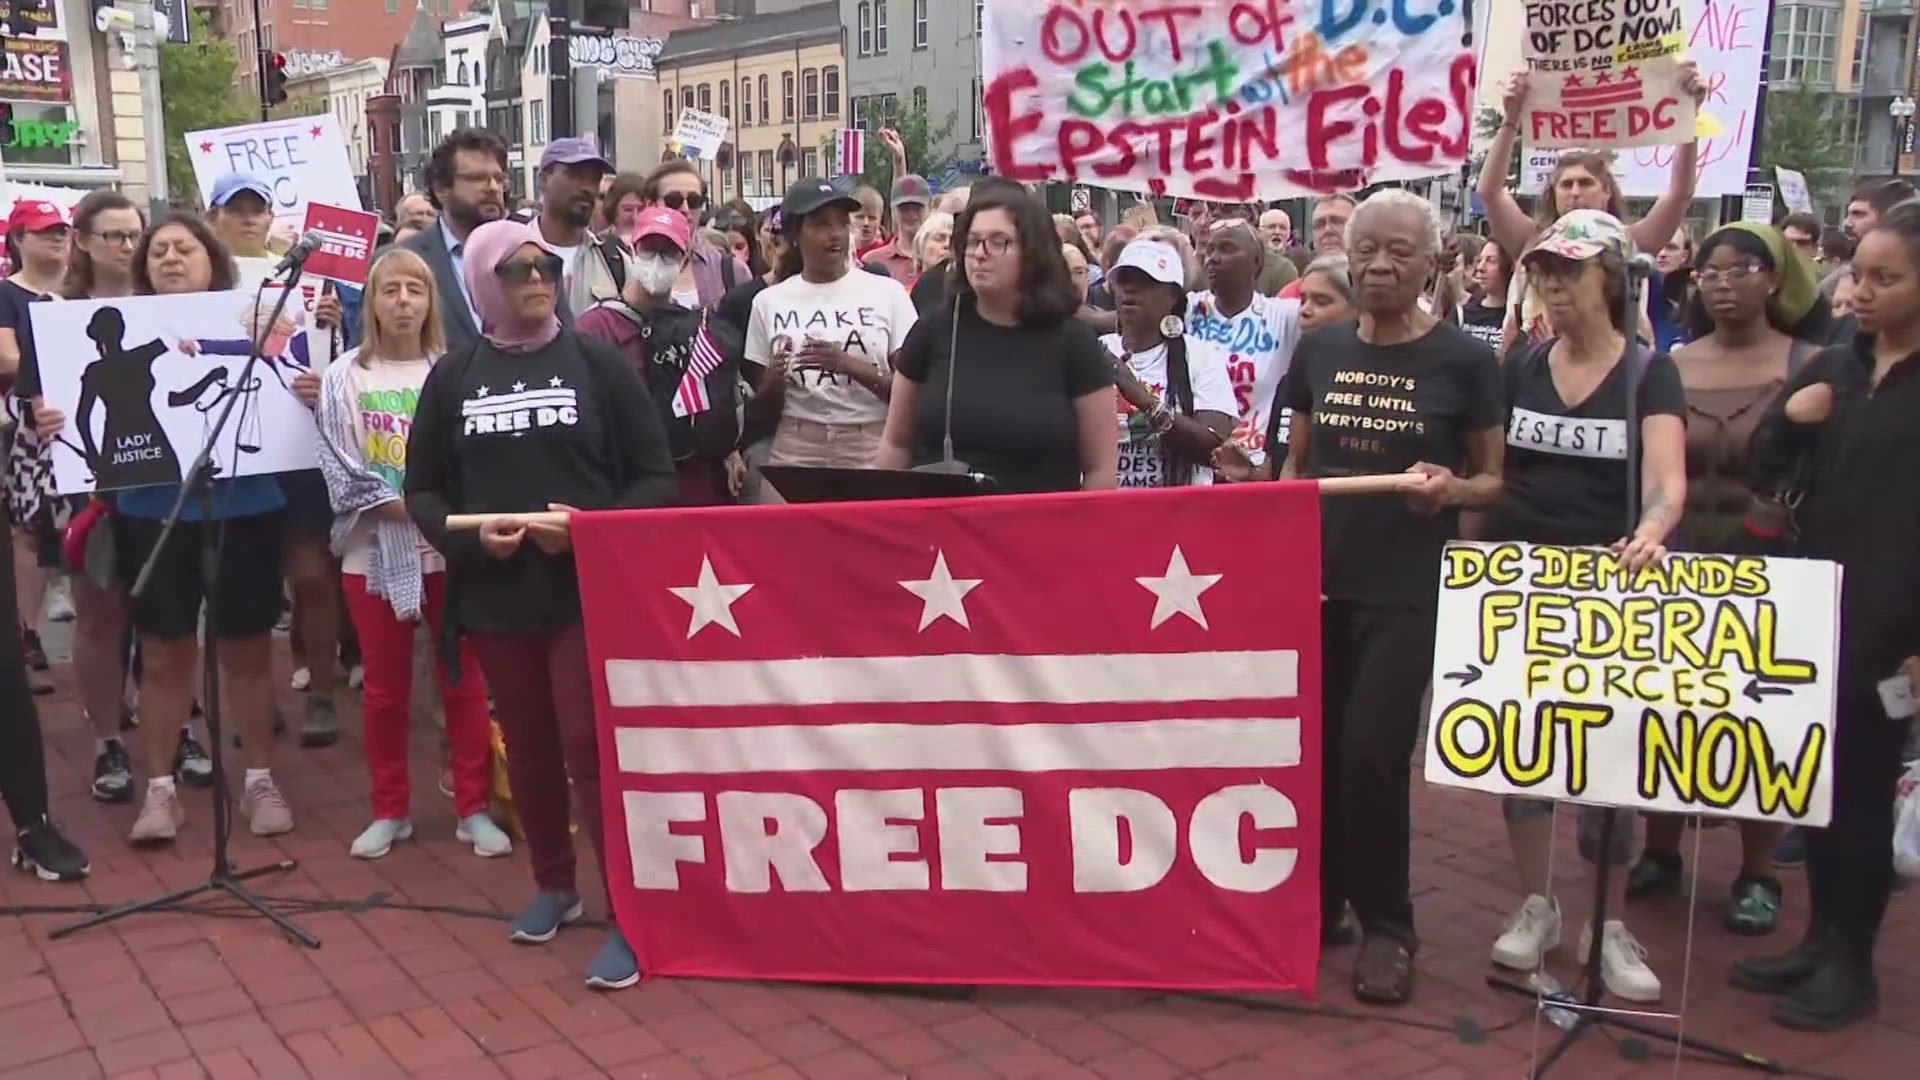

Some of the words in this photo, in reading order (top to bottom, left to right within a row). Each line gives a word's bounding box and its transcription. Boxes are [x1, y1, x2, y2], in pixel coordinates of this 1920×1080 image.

[1526, 2, 1615, 27] FORCES
[1531, 31, 1566, 53] OF
[1574, 25, 1613, 53] DC
[1618, 7, 1681, 45] NOW!
[1041, 5, 1202, 64] OUT
[1526, 56, 1571, 71] THERE
[1574, 57, 1588, 69] IS
[1592, 56, 1612, 66] NO
[1531, 109, 1617, 140] FREE
[1628, 97, 1678, 137] DC
[225, 135, 309, 172] FREE
[273, 176, 298, 208] C
[774, 306, 876, 332] MAKE
[1334, 371, 1416, 391] NOBODY'S
[1324, 392, 1363, 407] FREE
[1367, 395, 1417, 413] UNTIL
[362, 412, 394, 433] FOR
[463, 409, 531, 436] FREE
[537, 406, 579, 427] DC
[111, 446, 162, 465] JUSTICE
[116, 433, 152, 449] LADY
[1445, 544, 1523, 588] DC
[1531, 545, 1770, 596] DEMANDS
[1479, 590, 1817, 683] FEDERAL
[1527, 659, 1732, 708] FORCES
[1435, 697, 1613, 795] OUT
[1638, 708, 1826, 817] NOW
[622, 786, 1028, 893] FREE
[1069, 783, 1299, 893] DC
